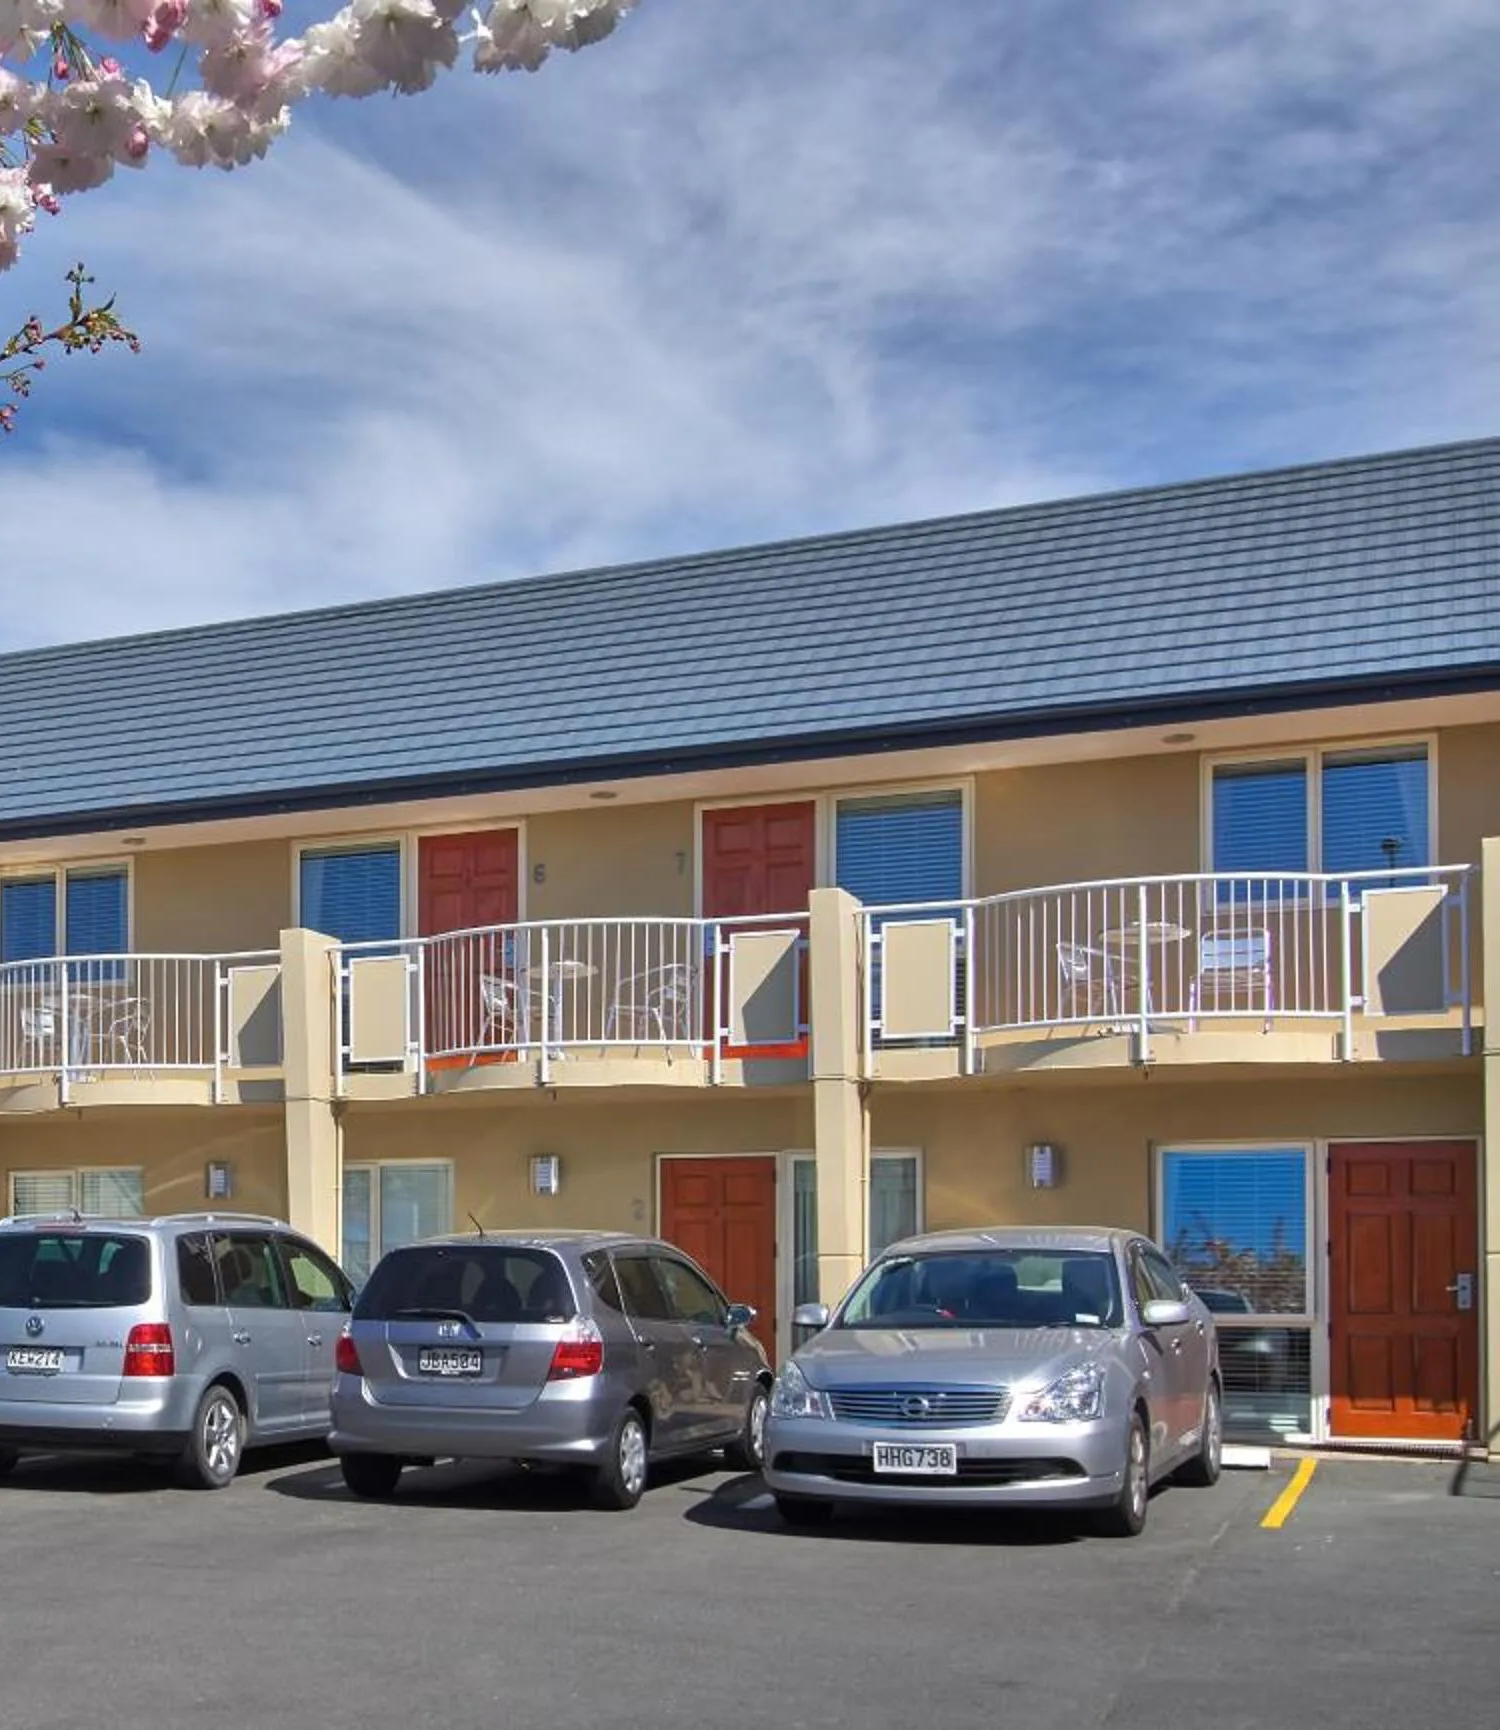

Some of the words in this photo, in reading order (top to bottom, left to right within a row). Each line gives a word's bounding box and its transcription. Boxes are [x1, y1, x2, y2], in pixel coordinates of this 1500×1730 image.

[533, 863, 546, 885] 6
[674, 851, 687, 876] 7
[877, 1447, 951, 1468] HHG738
